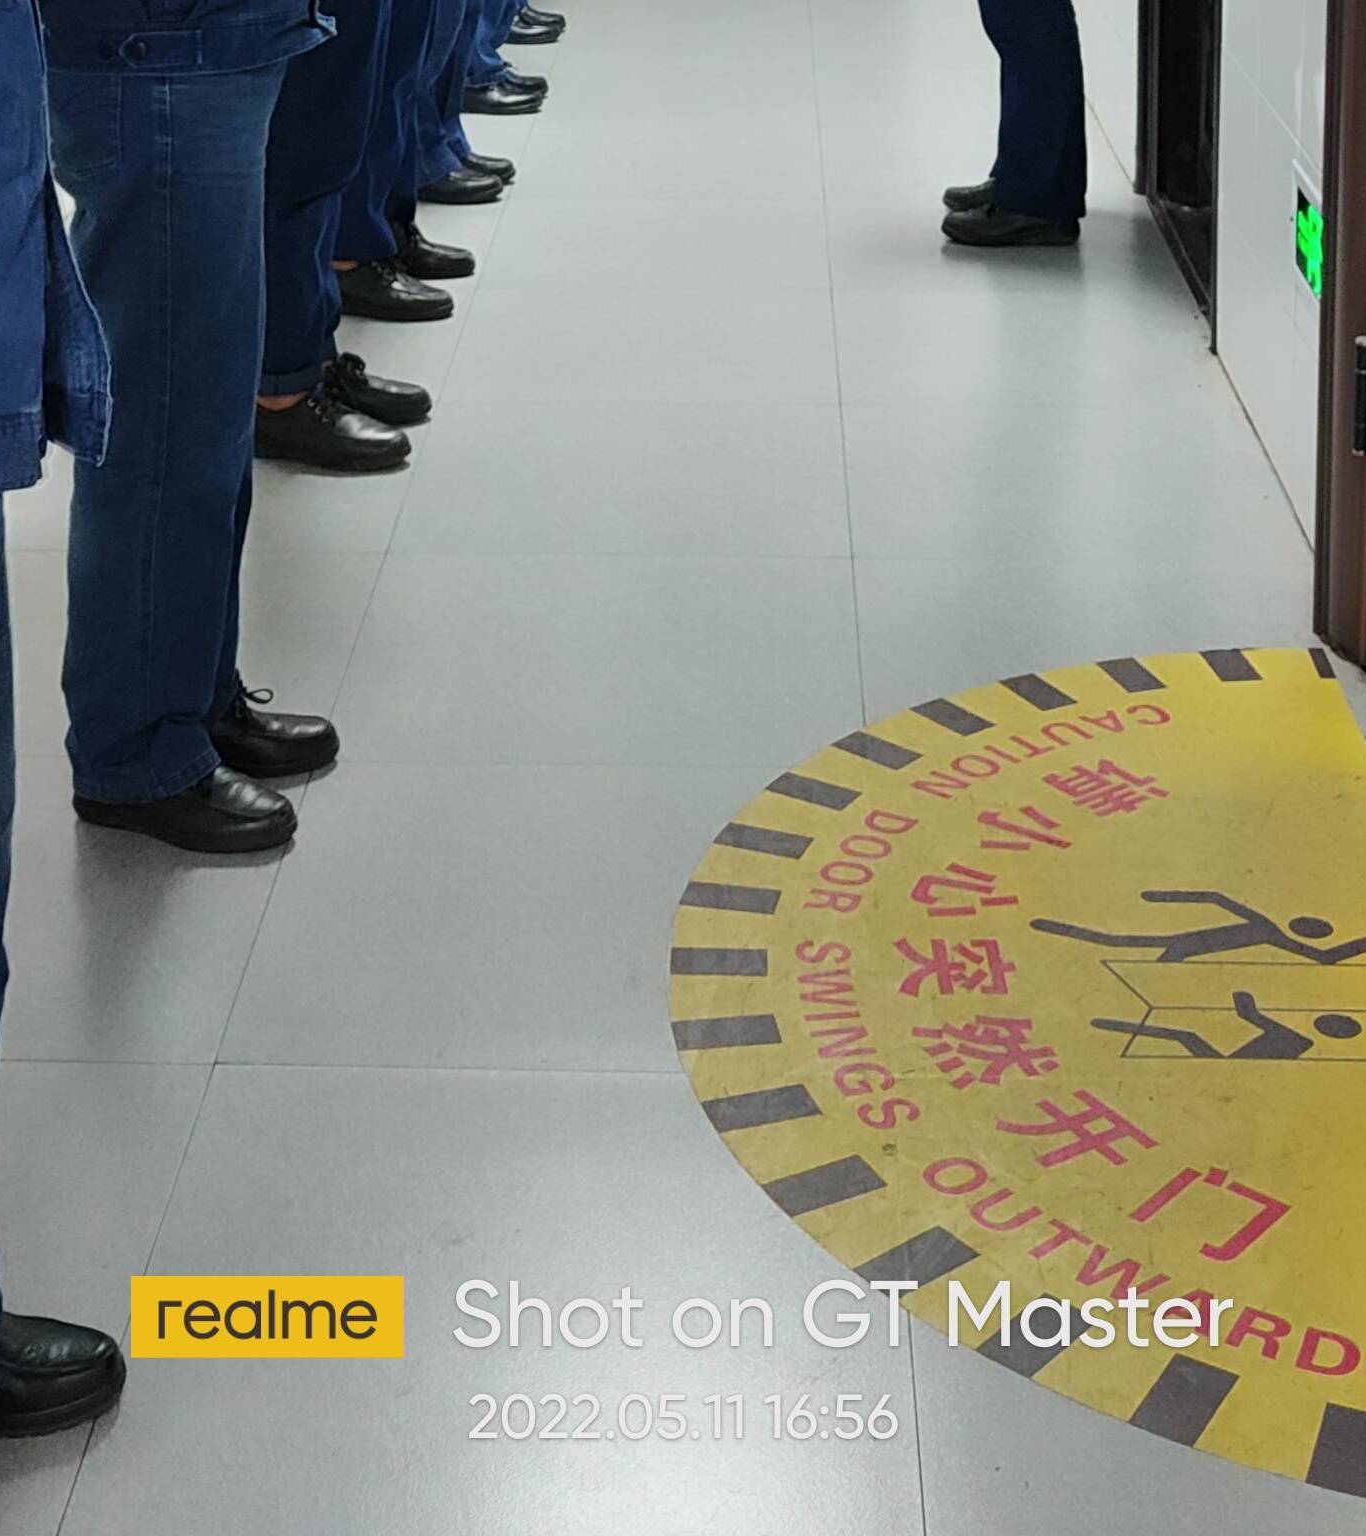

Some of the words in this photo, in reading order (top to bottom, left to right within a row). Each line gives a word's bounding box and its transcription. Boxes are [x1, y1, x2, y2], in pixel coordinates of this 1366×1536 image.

[913, 703, 1171, 799] CAUTION
[805, 809, 919, 915] DOOR
[795, 939, 921, 1130] SWINGS
[893, 758, 1291, 1263] 请小心突然开门
[923, 1156, 1361, 1378] OUTWARD
